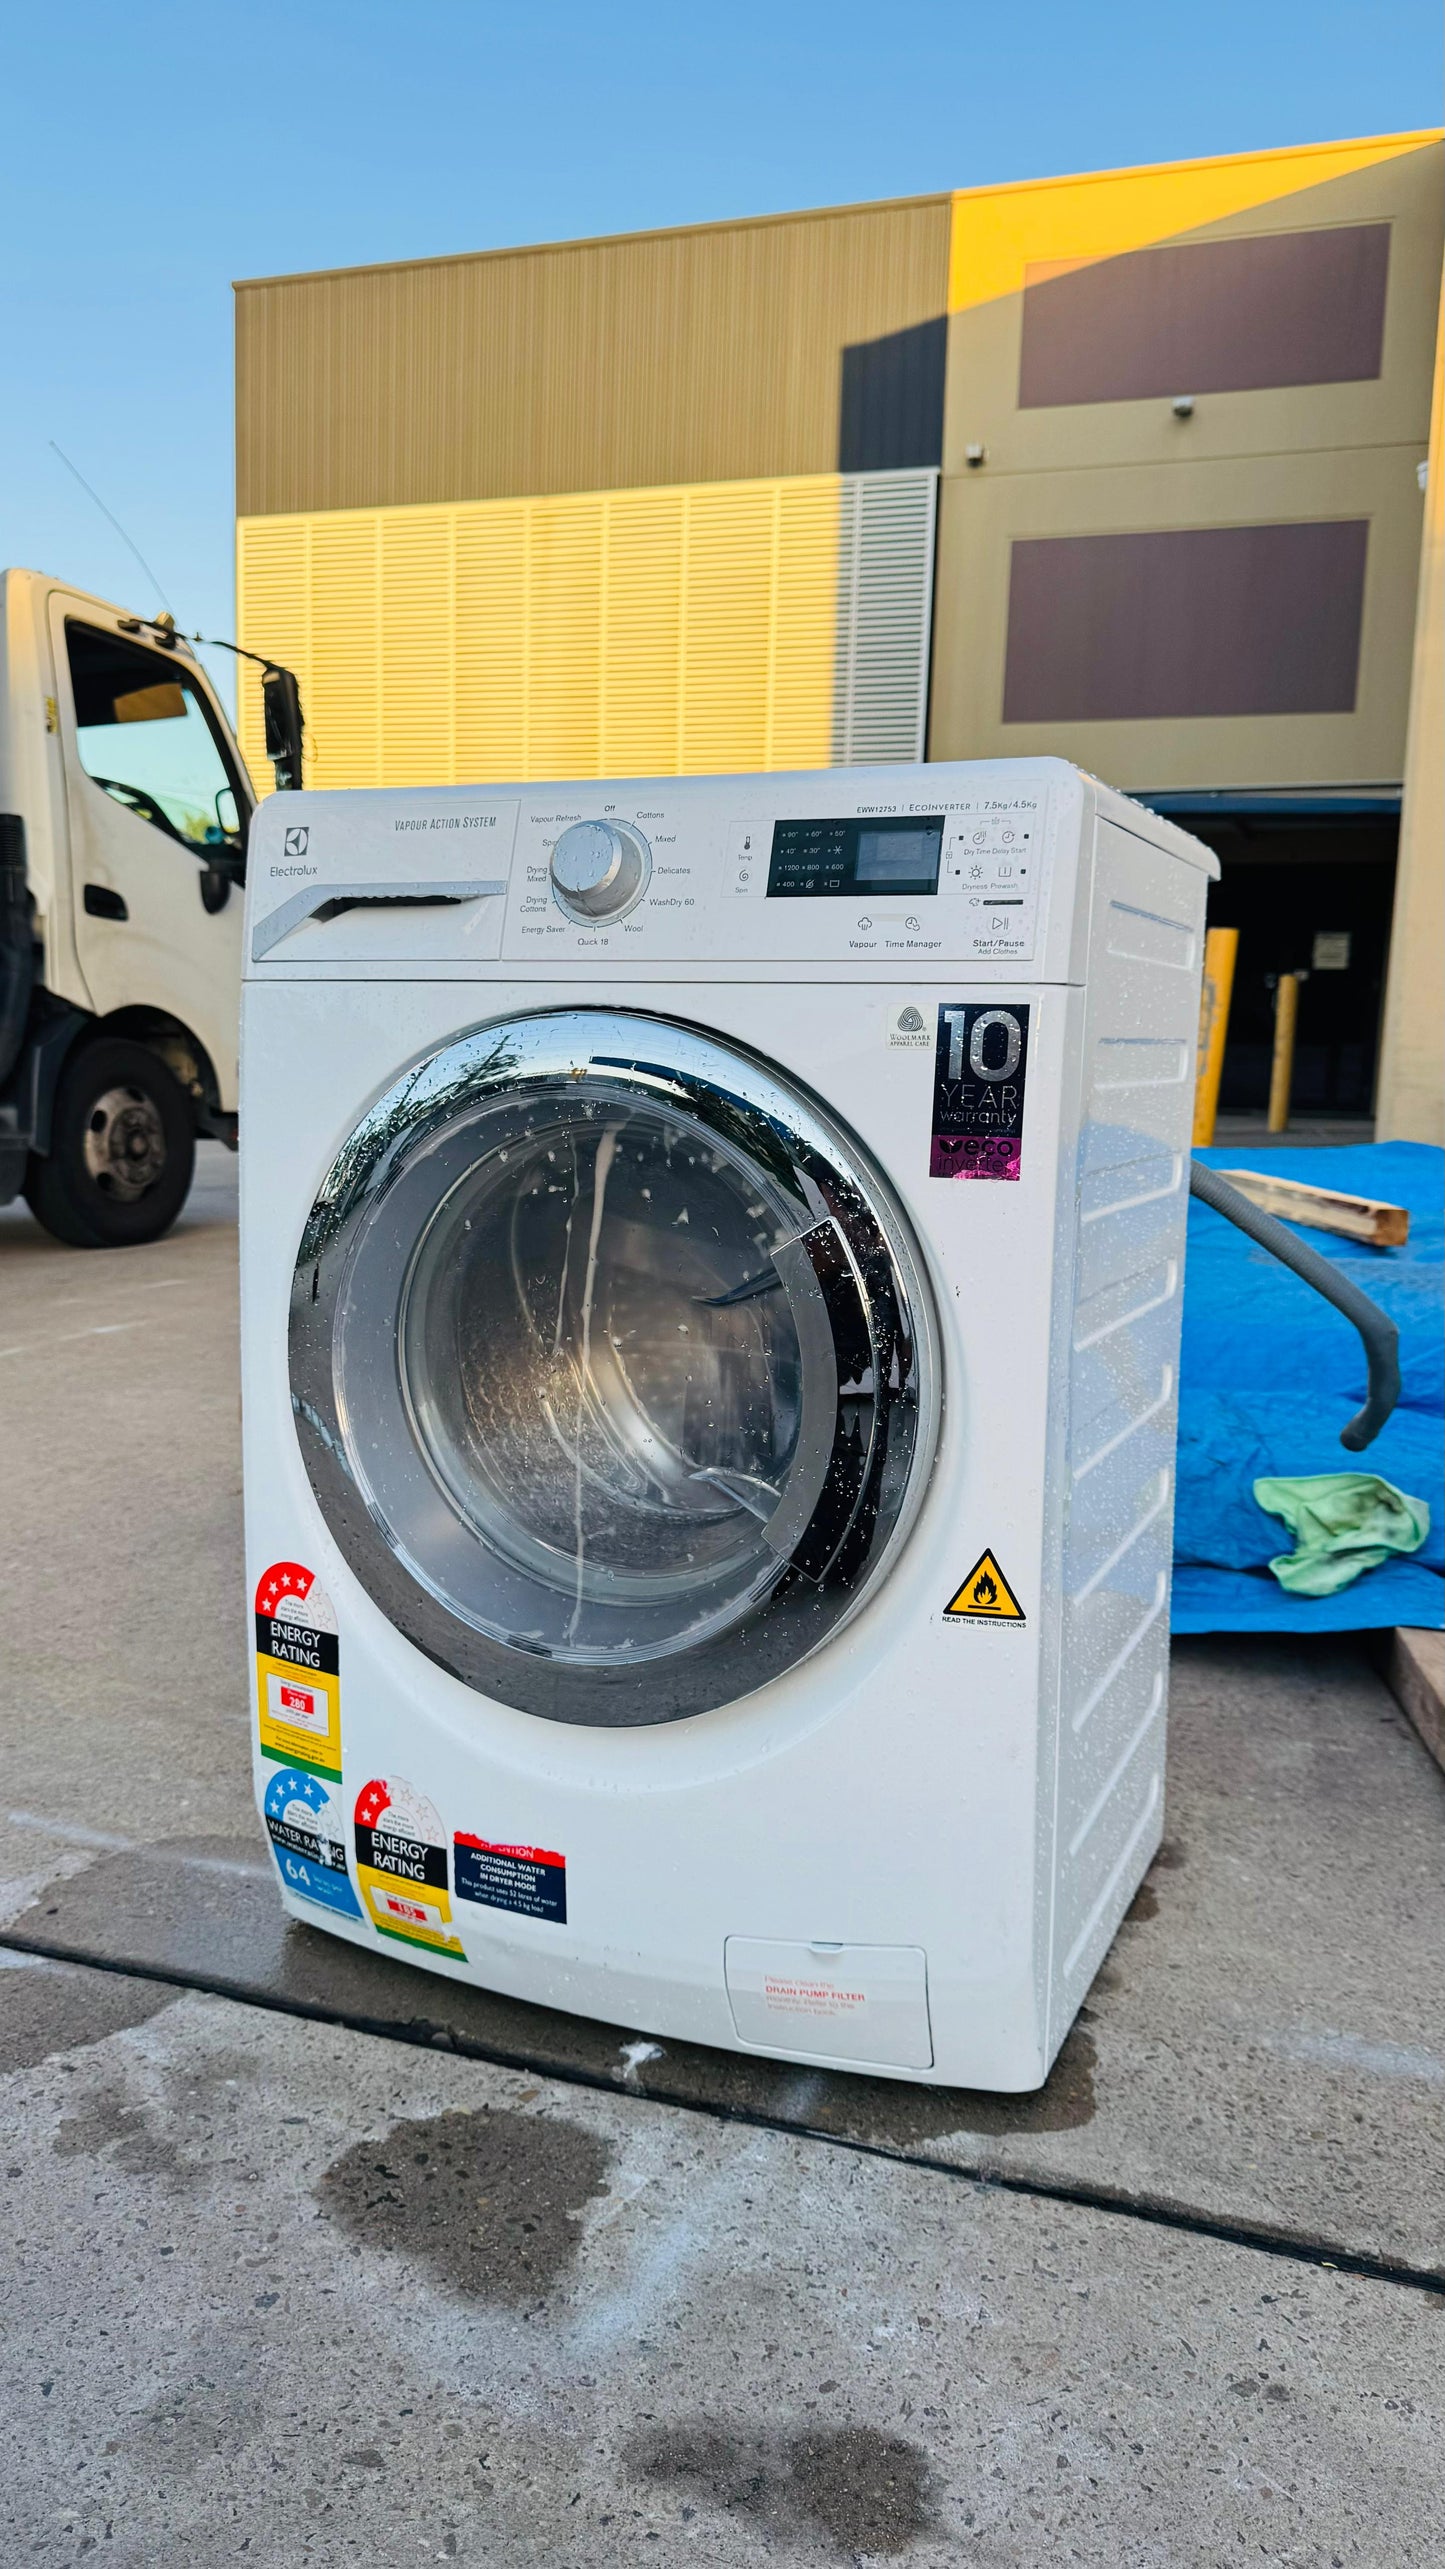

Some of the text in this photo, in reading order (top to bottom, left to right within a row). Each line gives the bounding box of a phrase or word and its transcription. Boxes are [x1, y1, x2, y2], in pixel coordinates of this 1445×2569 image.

[556, 814, 581, 822] Refresh
[637, 811, 664, 819] Cottons
[992, 848, 1009, 856] Delay
[270, 865, 317, 877] Electrolux
[527, 866, 548, 875] Drying
[526, 896, 548, 904] Drying
[650, 899, 682, 907] WashDry
[521, 925, 565, 934] Energy Saver
[578, 938, 598, 946] Quick
[906, 940, 942, 949] Manager
[944, 1010, 1021, 1082] 10
[941, 1084, 1016, 1109] YEAR
[940, 1110, 1016, 1127] warranty
[964, 1140, 1013, 1156] eco
[977, 1620, 1026, 1628] INSTRUCTIONS
[271, 1621, 320, 1647] ENERGY
[272, 1640, 320, 1667] RATING
[289, 1697, 305, 1710] 280
[267, 1819, 301, 1844] WATER
[303, 1835, 344, 1861] RANG
[371, 1831, 428, 1860] ENERGY
[286, 1858, 311, 1886] 64
[374, 1851, 425, 1880] RATING
[470, 1852, 546, 1876] ADDITIONAL WATER
[480, 1864, 536, 1883] CONSUMPTION
[461, 1877, 472, 1886] This
[473, 1882, 495, 1891] product
[496, 1887, 508, 1895] uses
[490, 1874, 513, 1886] DRYER
[514, 1880, 536, 1892] MODE
[766, 1986, 865, 2001] DRAIN PUMP FILTER
